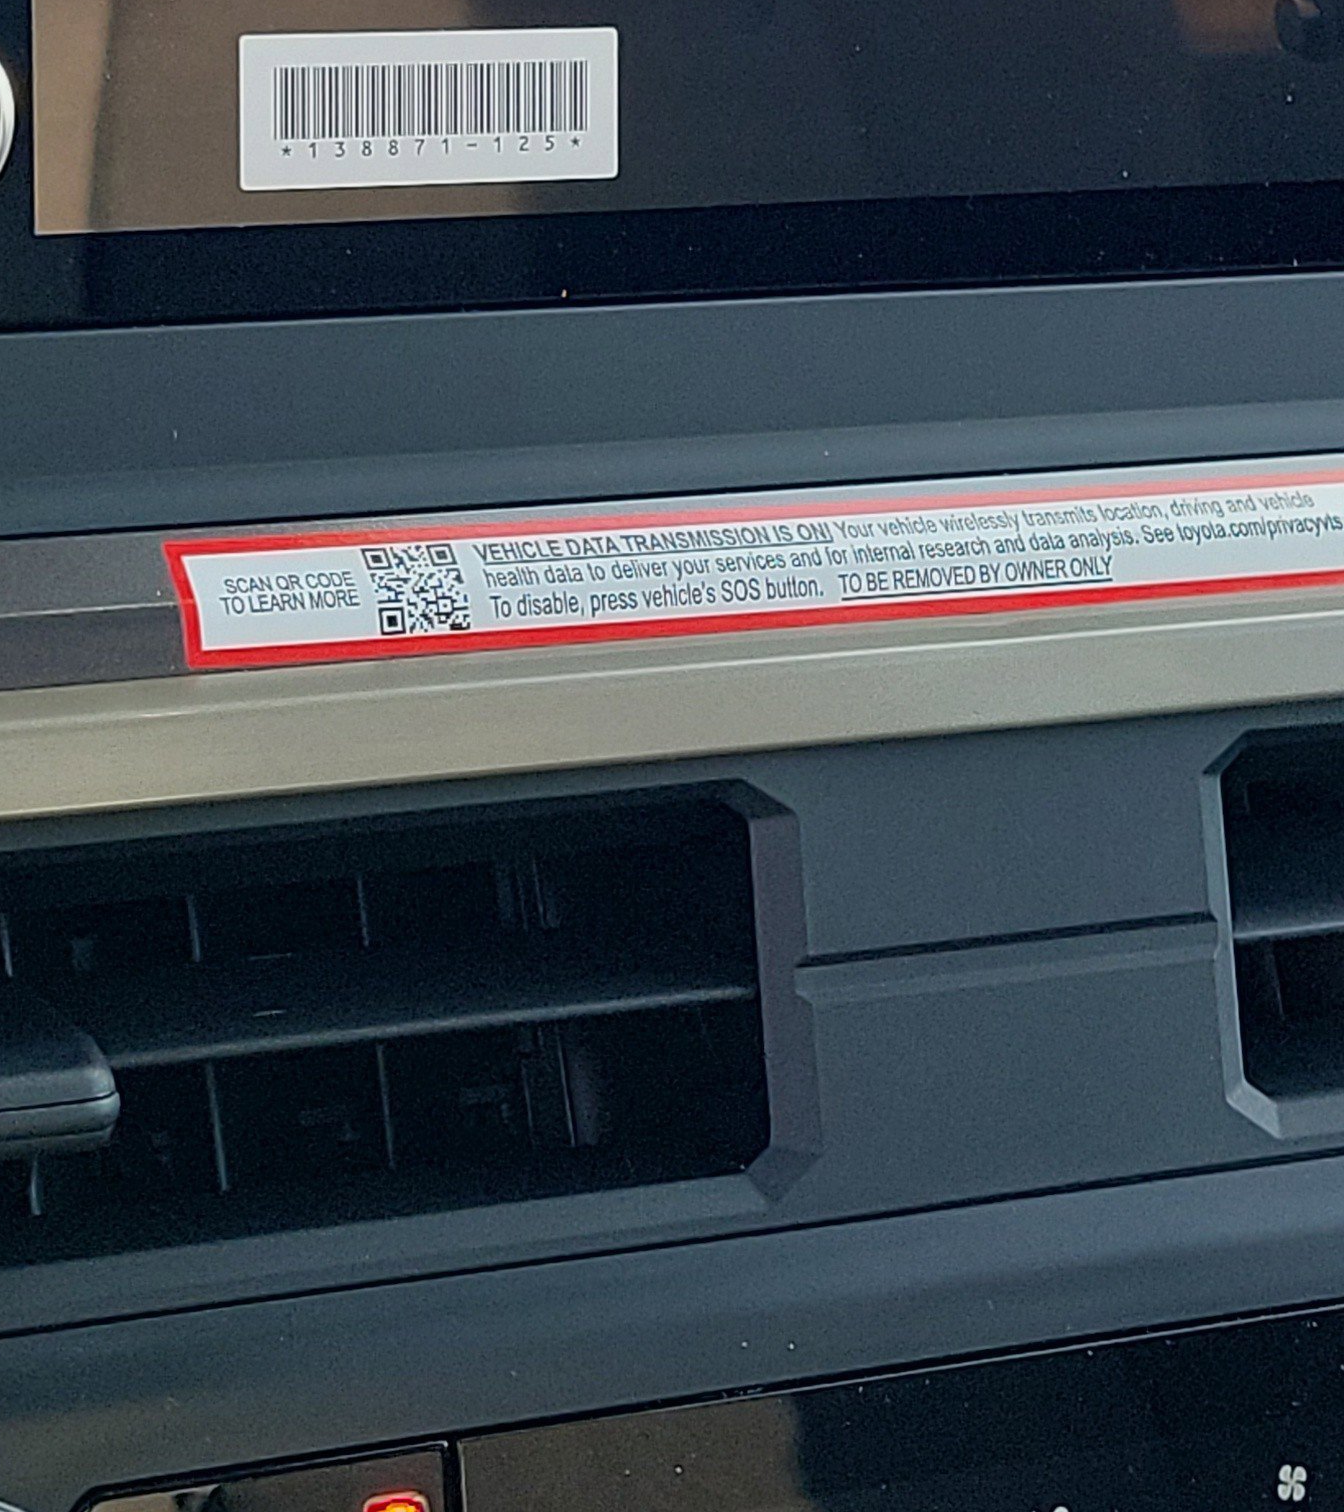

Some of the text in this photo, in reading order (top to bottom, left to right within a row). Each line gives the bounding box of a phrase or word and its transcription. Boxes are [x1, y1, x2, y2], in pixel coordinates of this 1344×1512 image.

[472, 538, 564, 566] VEHICLE
[564, 536, 621, 558] DATA
[624, 525, 771, 553] TRANSMISSION
[771, 524, 794, 543] IS
[833, 518, 875, 541] Your
[875, 514, 938, 537] vehicle
[940, 509, 1021, 536] wirelessly
[1022, 505, 1099, 528] transmits
[1098, 498, 1170, 523] location,
[1170, 498, 1225, 519] driving
[1225, 494, 1257, 514] and
[1256, 490, 1316, 511] vehicle
[483, 563, 542, 589] health
[544, 564, 584, 585] data
[585, 561, 607, 583] to
[611, 556, 669, 580] deliver
[670, 556, 712, 582] your
[715, 551, 787, 573] services
[789, 546, 823, 568] and
[824, 544, 849, 566] for
[851, 539, 916, 564] internal
[918, 535, 992, 561] research
[994, 532, 1027, 555] and
[1029, 530, 1067, 552] data
[1068, 525, 1141, 554] analysis.
[1140, 523, 1175, 544] See
[219, 588, 362, 616] TO LEARN MORE
[224, 570, 357, 596] SCAN QR CODE
[488, 553, 1114, 619] To disable, press vehicle's SOS button. TO BE REMOVED BY OWNER ONLY
